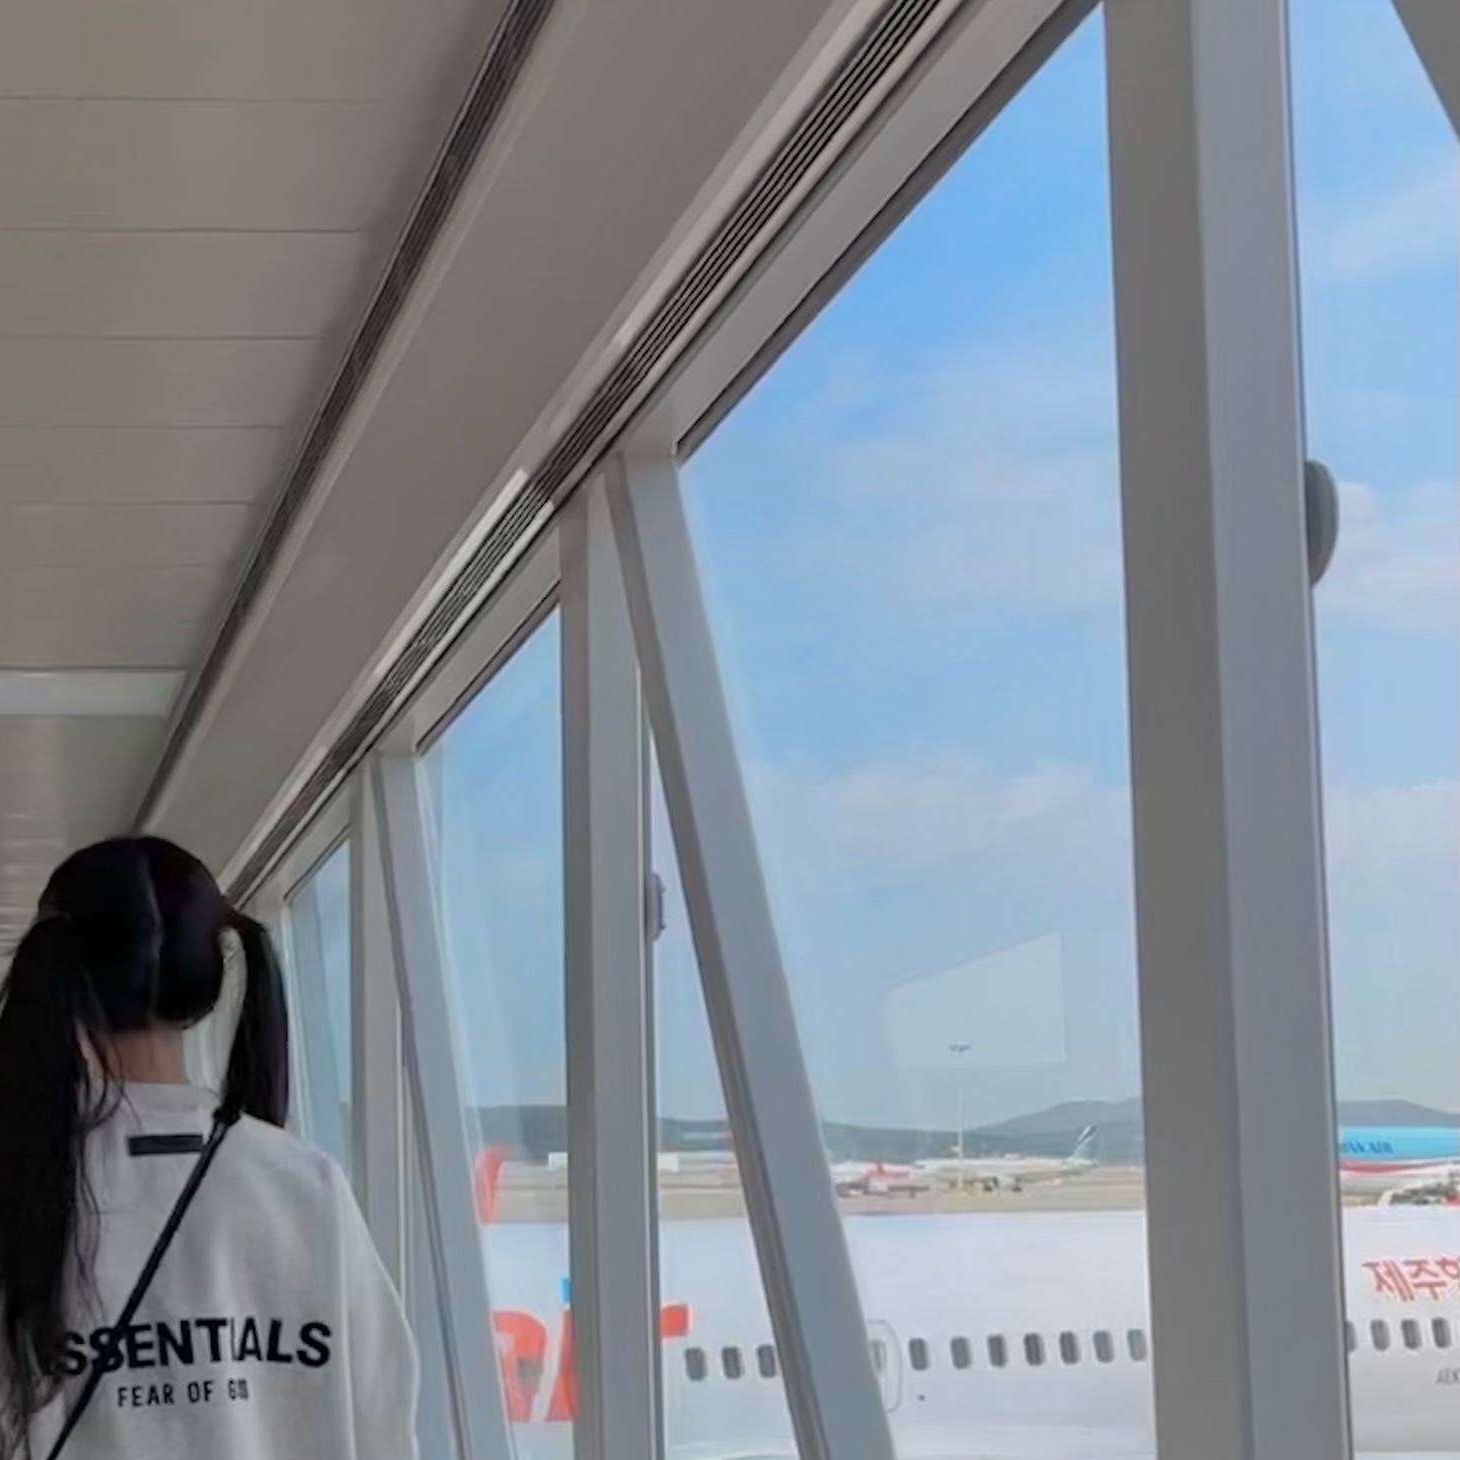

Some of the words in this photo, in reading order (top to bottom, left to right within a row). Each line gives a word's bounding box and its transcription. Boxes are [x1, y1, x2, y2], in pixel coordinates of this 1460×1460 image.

[58, 1316, 332, 1375] SSENTIALS
[117, 1382, 175, 1407] FEAR
[187, 1379, 214, 1403] OF
